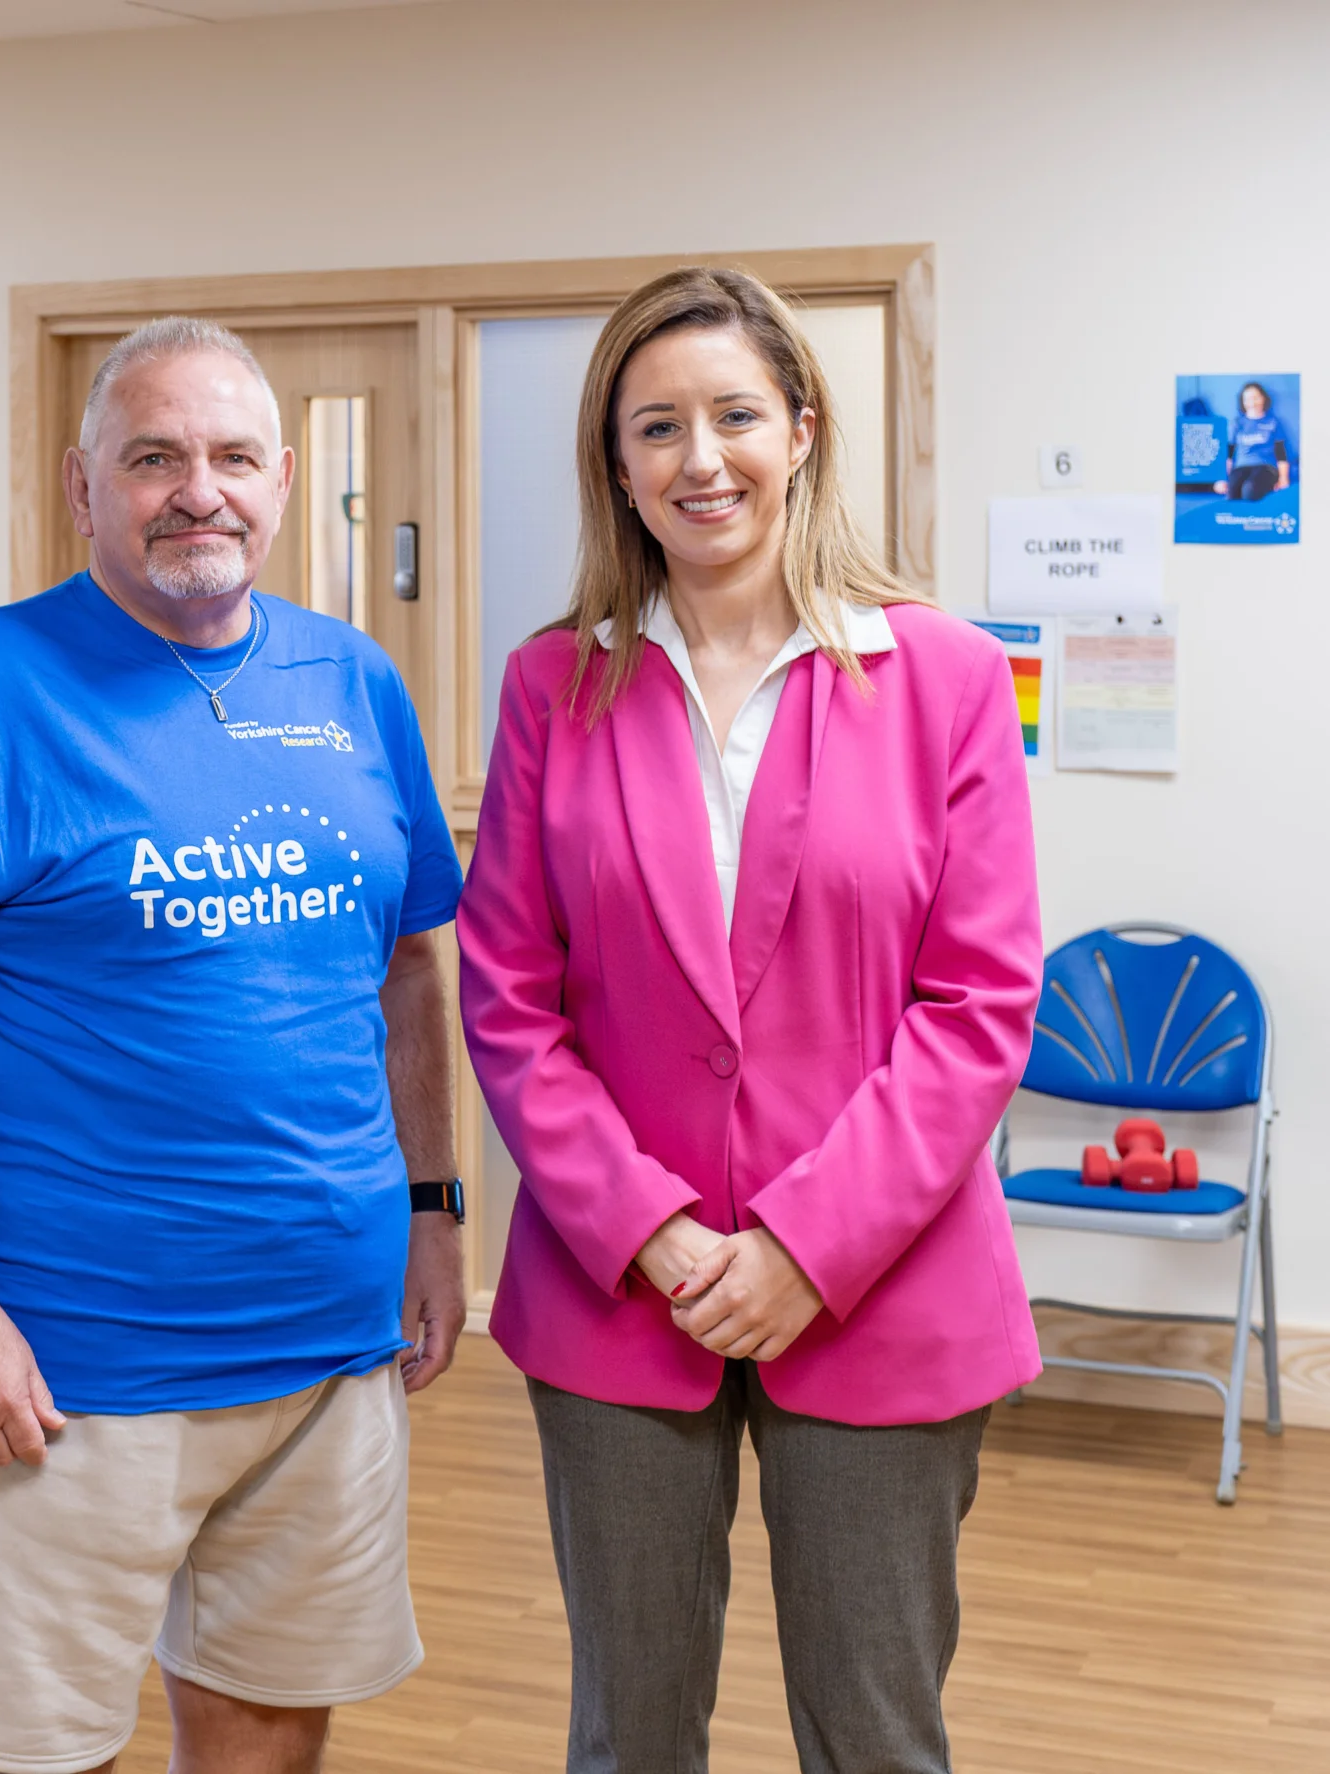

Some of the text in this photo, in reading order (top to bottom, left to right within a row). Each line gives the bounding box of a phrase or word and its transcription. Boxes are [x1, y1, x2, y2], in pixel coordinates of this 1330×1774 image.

[1055, 451, 1071, 476] 6
[1024, 538, 1124, 554] CLIMB THE
[1048, 562, 1100, 579] ROPE
[223, 721, 249, 730] Funded
[227, 724, 322, 740] Yorkshire Cancer
[280, 735, 328, 747] Research
[129, 836, 308, 886] Active
[129, 883, 356, 938] Together.
